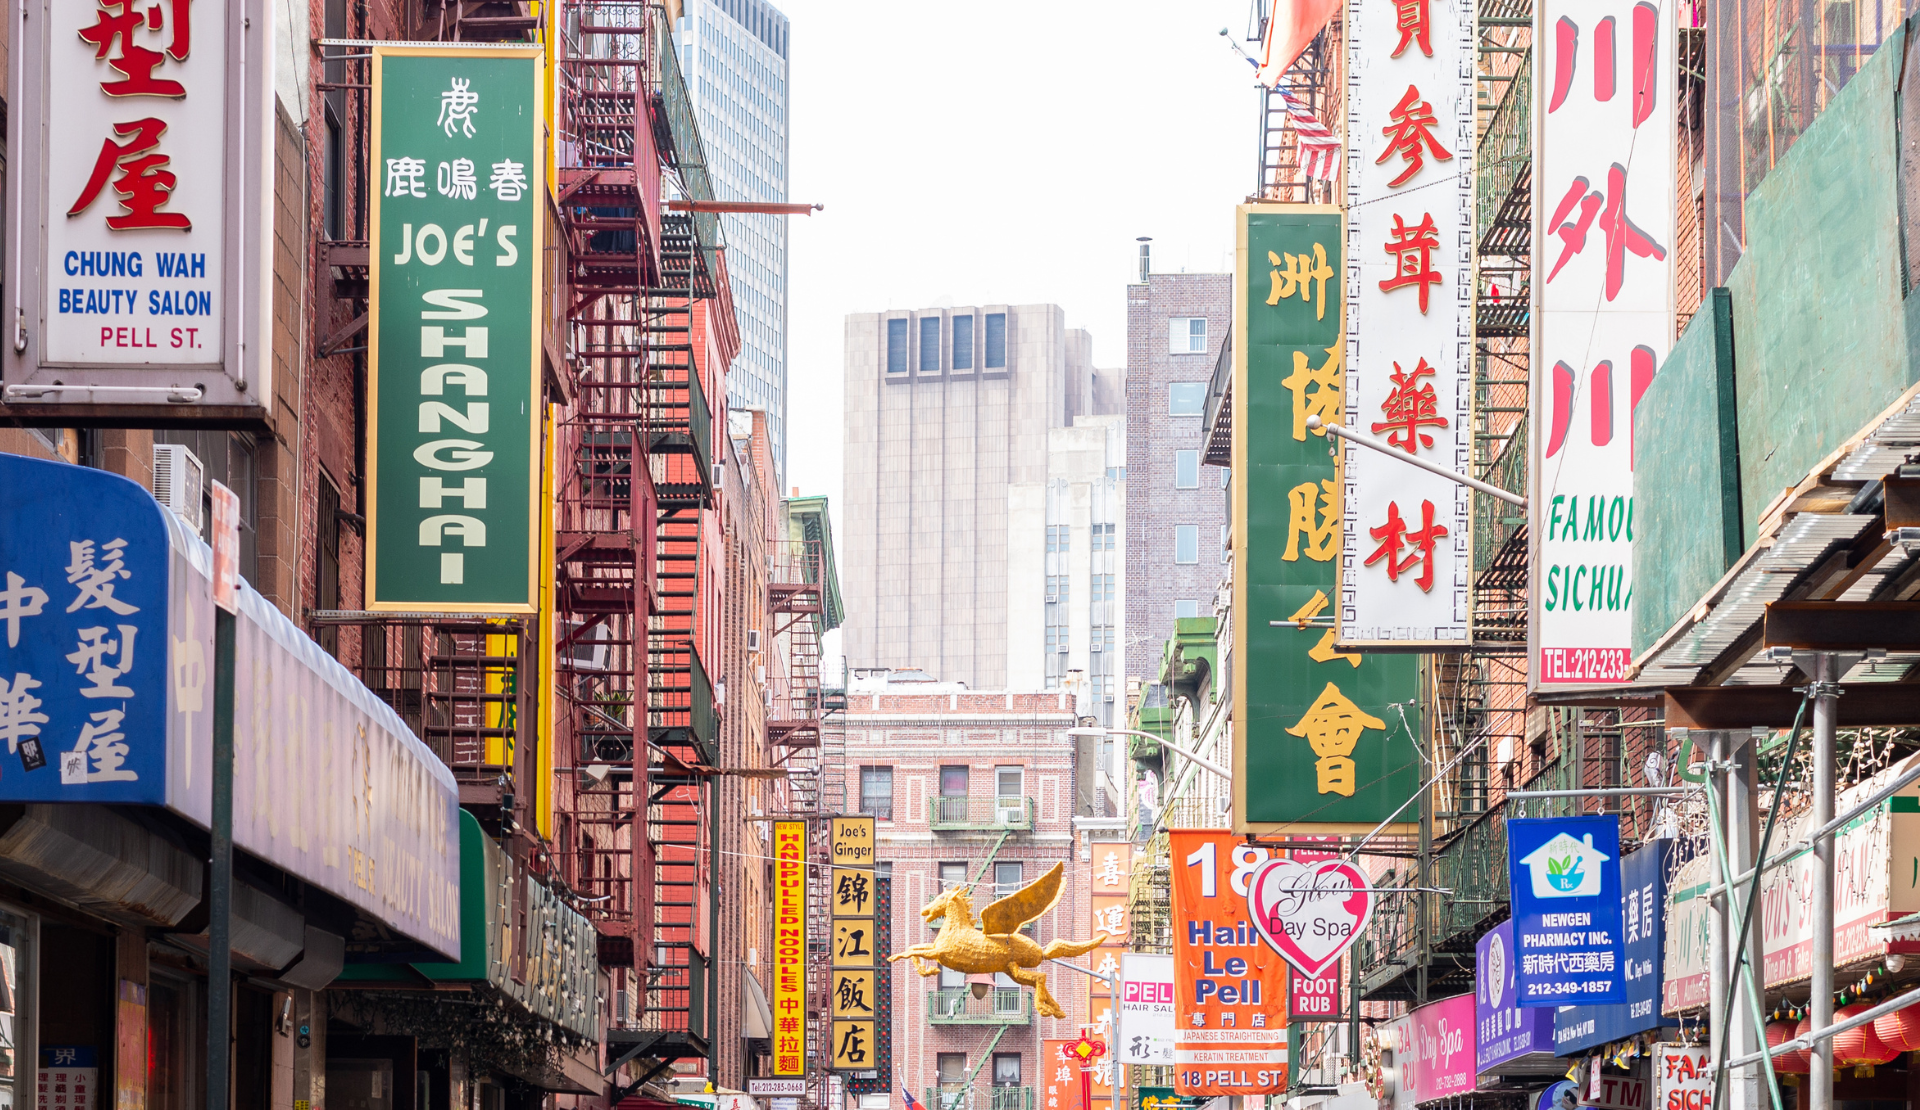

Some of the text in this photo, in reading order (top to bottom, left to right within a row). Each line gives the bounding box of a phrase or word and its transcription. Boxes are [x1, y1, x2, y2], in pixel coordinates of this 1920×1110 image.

[68, 0, 191, 231] 型屋
[385, 157, 528, 201] 鹿鳴春
[394, 218, 519, 266] JOE'S
[1546, 1, 1666, 473] 川外川
[64, 250, 205, 277] CHUNG WAH
[1266, 242, 1333, 321] 洲
[59, 288, 211, 316] BEAUTY SALON
[101, 327, 202, 348] PELL ST.
[413, 289, 494, 584] SHANGHAI
[1545, 564, 1632, 612] SICHU
[0, 570, 50, 754] 中華
[65, 537, 140, 782] 髮型屋
[1545, 648, 1632, 679] TEL:212-233-
[840, 824, 866, 838] Joe's
[834, 842, 872, 859] Ginger
[780, 834, 799, 925] HANDPULLED
[1187, 842, 1269, 898] 18
[428, 868, 459, 943] SALON
[1761, 878, 1792, 943] OUS
[1188, 921, 1259, 946] Hair
[1270, 917, 1352, 940] Day Spa
[1542, 913, 1590, 927] NEWGEN
[1523, 931, 1613, 948] PHARMACY INC.
[779, 929, 798, 992] NOODLES
[835, 873, 873, 1063] 錦江飯店
[1204, 951, 1248, 977] Le
[1523, 951, 1615, 976] 新時代西藥房
[1794, 945, 1810, 974] Take
[1125, 982, 1175, 1003] PEL
[1196, 979, 1262, 1005] Pell
[1293, 979, 1336, 994] FOOT
[1528, 981, 1612, 995] 212-349-1857
[1153, 1005, 1175, 1013] SAL
[1299, 996, 1330, 1012] RUB
[1192, 1012, 1266, 1028] 專門店
[1183, 1031, 1218, 1041] JAPANESE
[1220, 1031, 1279, 1041] STRAIGHTENING
[1397, 1022, 1412, 1055] BA
[1438, 1018, 1464, 1070] Spa
[1193, 1052, 1268, 1062] KERATIN TREATMENT
[751, 1082, 803, 1092] Tel:212-285-0668
[1181, 1070, 1283, 1087] 18 PELL ST
